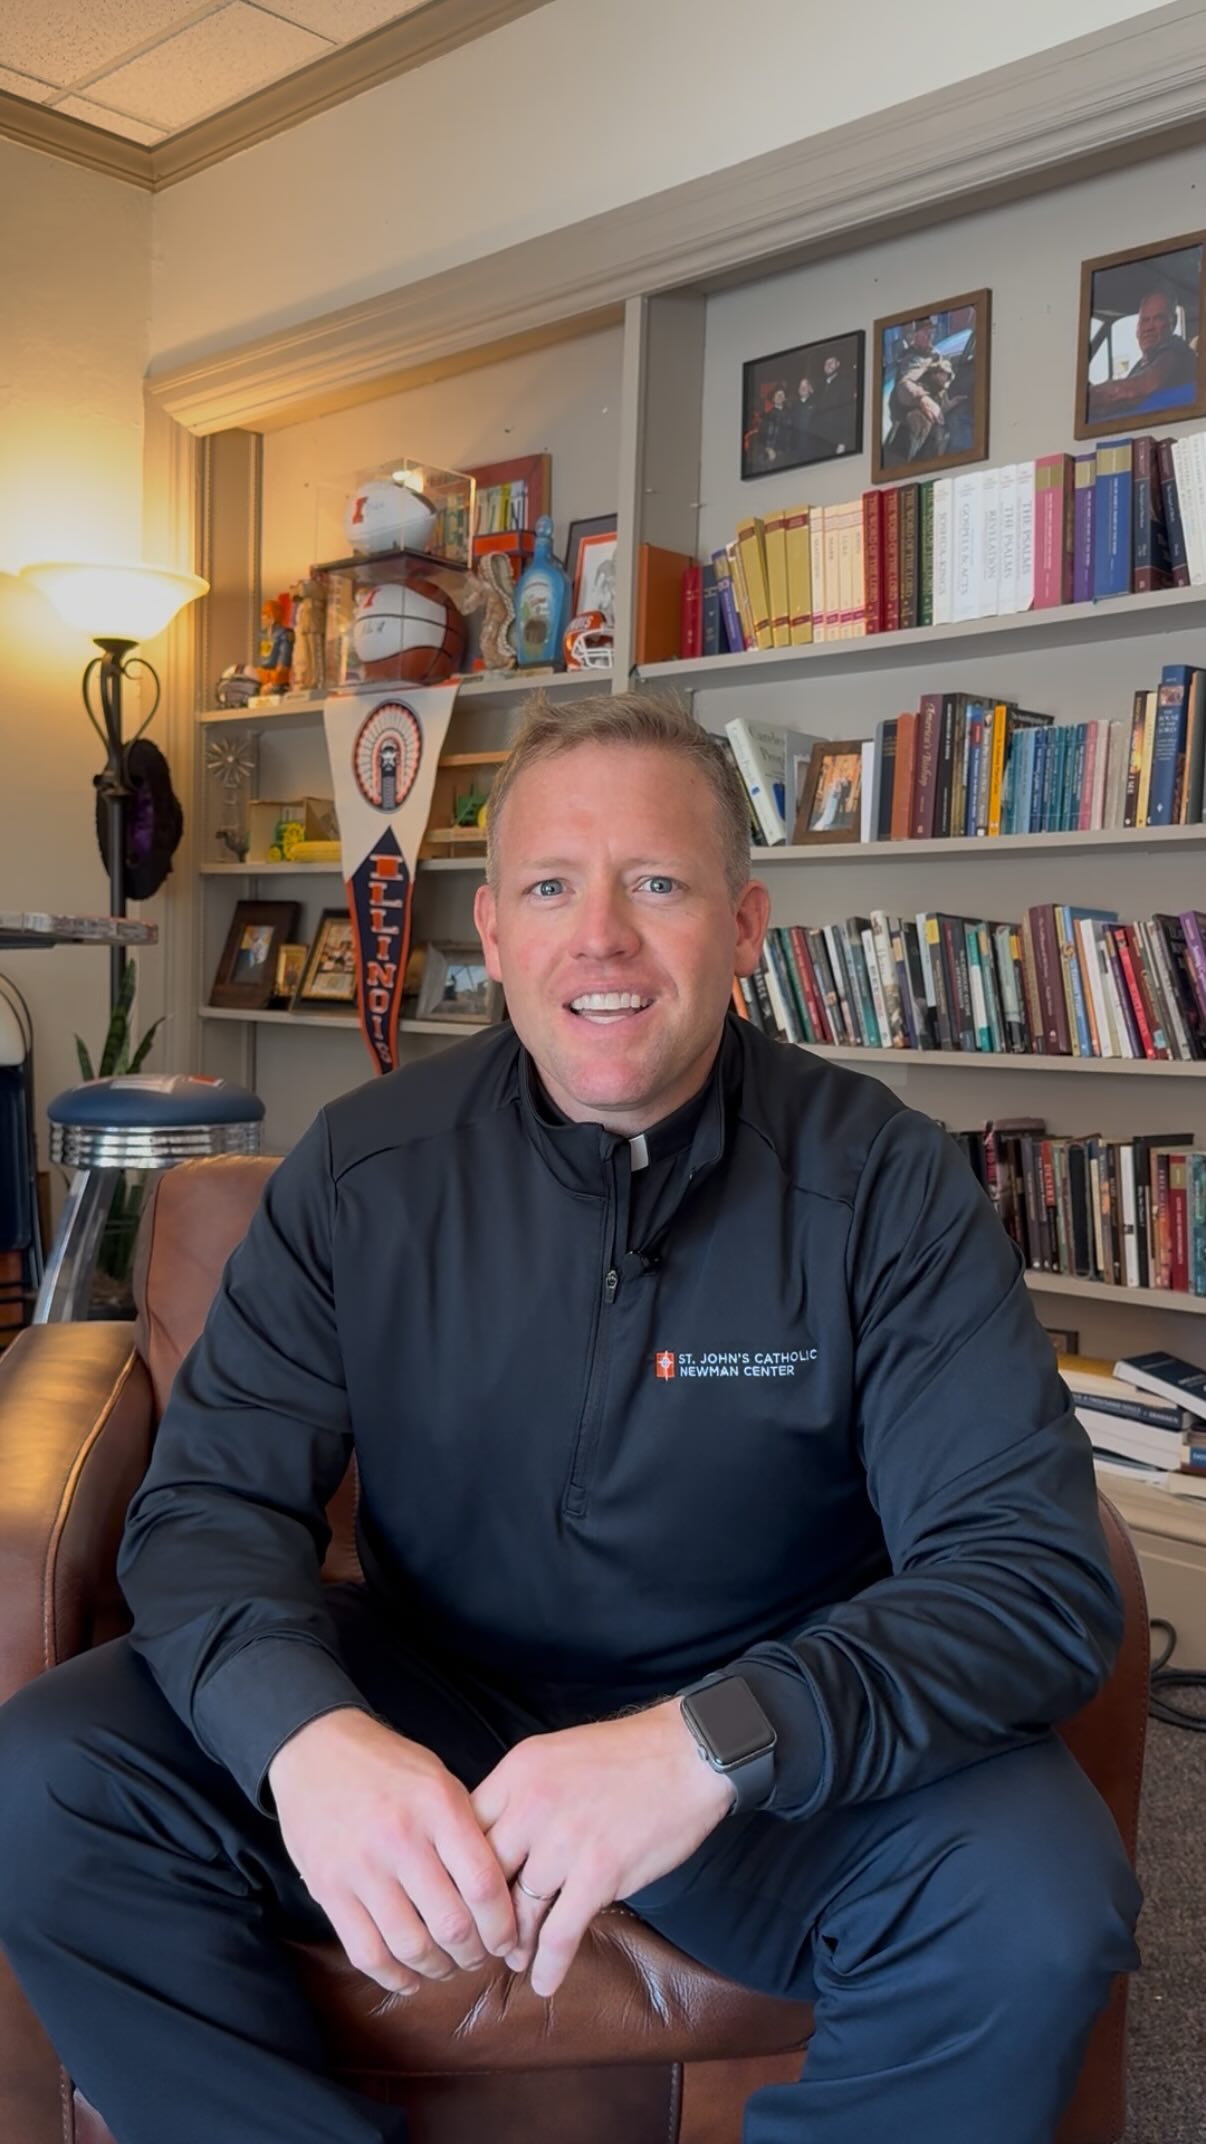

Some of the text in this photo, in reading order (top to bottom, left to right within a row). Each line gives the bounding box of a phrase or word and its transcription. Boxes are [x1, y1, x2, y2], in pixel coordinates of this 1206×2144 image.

[1003, 507, 1014, 579] THE PSALMS
[1022, 503, 1032, 575] THE PSALMS
[367, 854, 403, 1063] ILLINOIS
[679, 1349, 818, 1364] ST. JOHN'S CATHOLIC
[680, 1365, 795, 1377] NEWMAN CENTER
